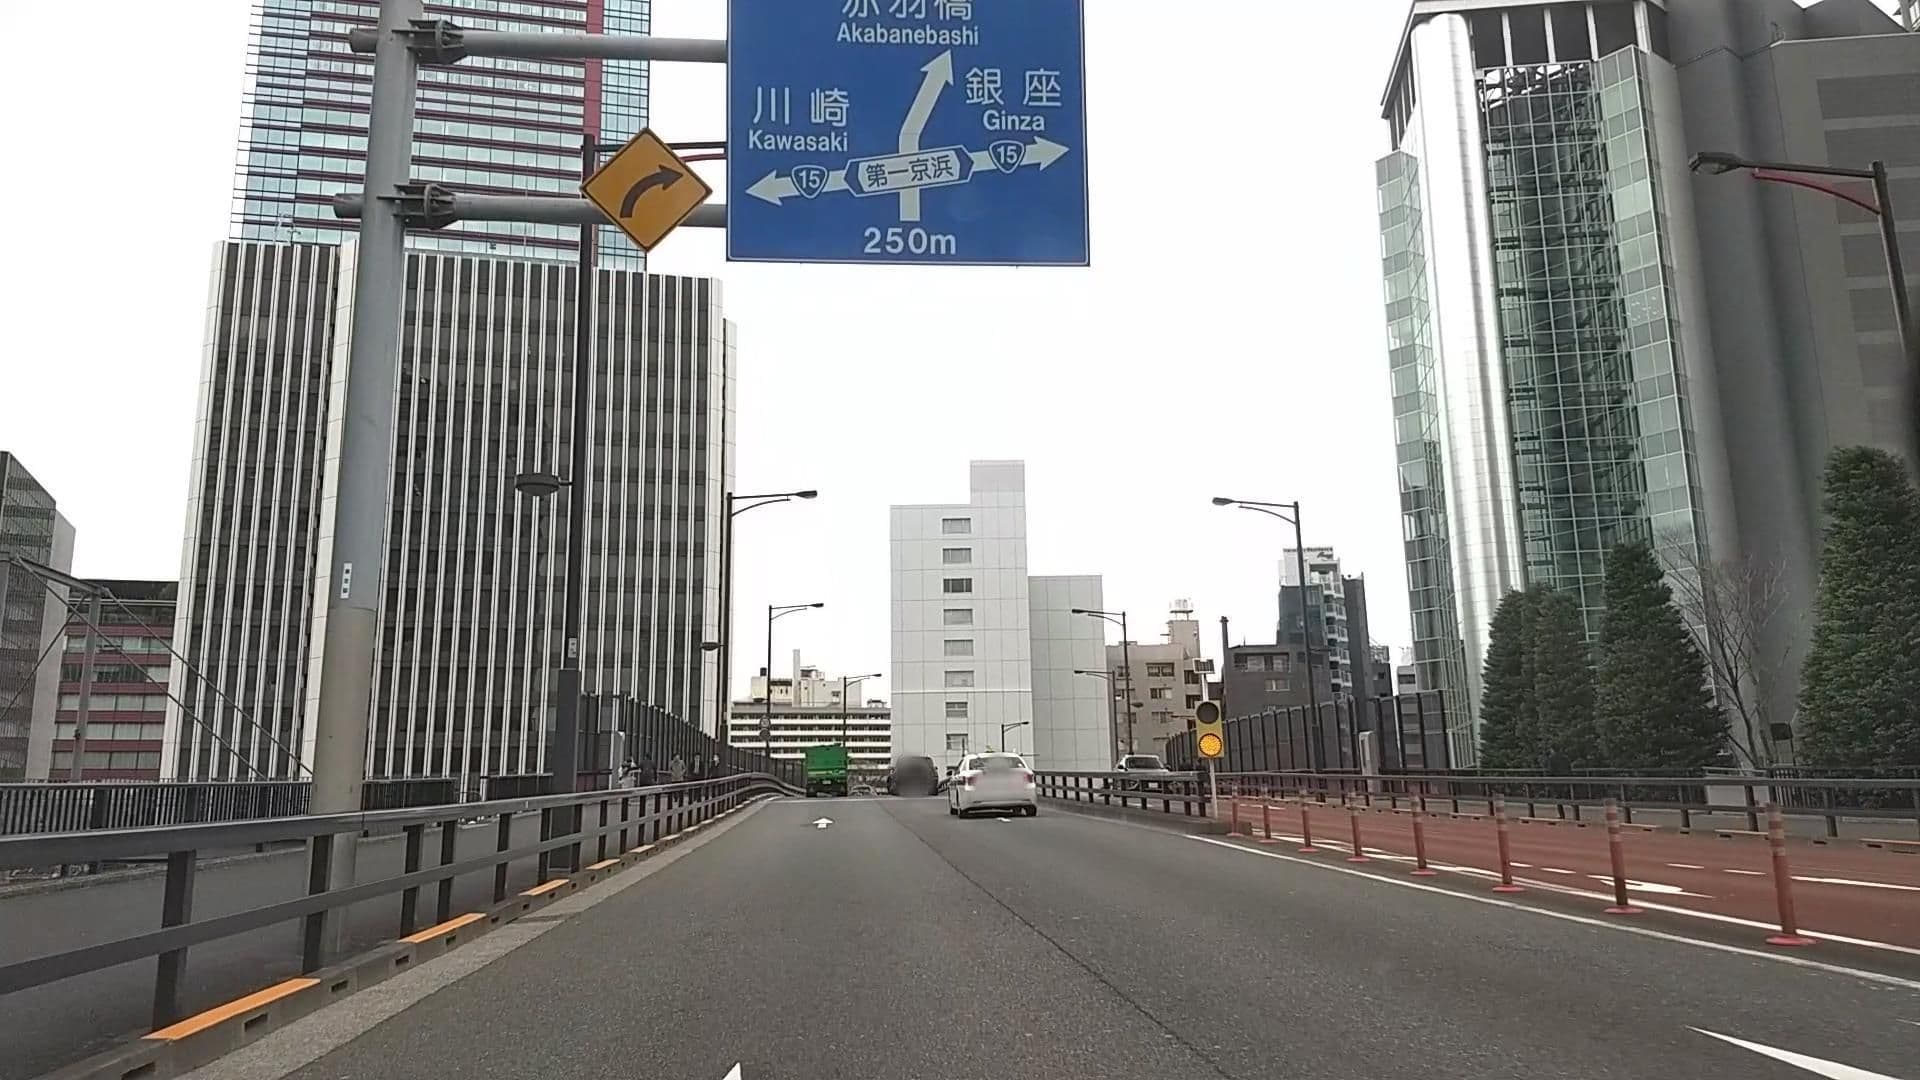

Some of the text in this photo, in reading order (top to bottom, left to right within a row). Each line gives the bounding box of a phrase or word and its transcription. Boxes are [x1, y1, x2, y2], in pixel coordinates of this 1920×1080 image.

[837, 23, 979, 46] Akabanebashi
[965, 67, 1062, 107] 銀座
[752, 86, 850, 127] 川崎
[983, 110, 1045, 131] Ginza
[748, 130, 848, 152] Kawasaki
[996, 146, 1018, 165] 15
[798, 170, 821, 189] 15
[865, 154, 954, 189] 第一京浜
[863, 227, 956, 255] 250m
